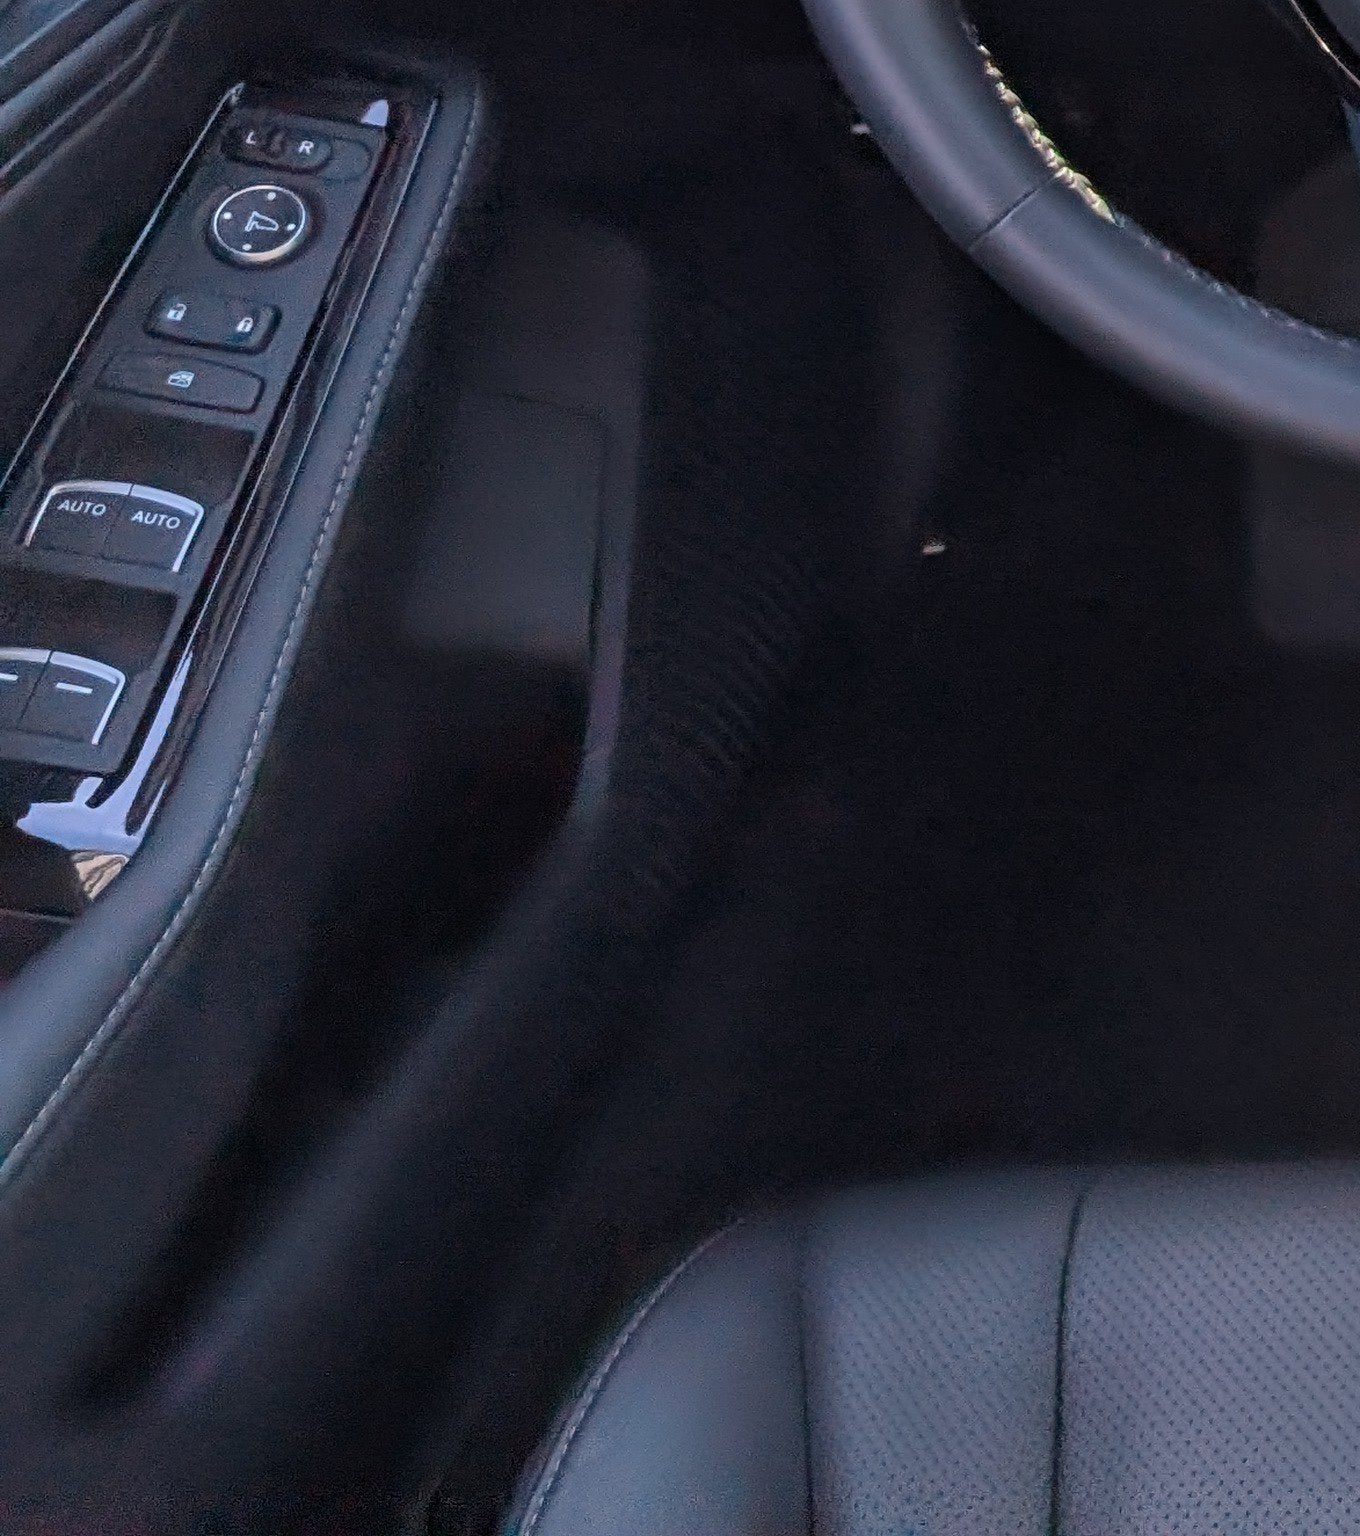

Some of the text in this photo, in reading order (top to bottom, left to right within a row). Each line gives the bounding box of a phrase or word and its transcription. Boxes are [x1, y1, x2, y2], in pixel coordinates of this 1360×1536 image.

[245, 129, 314, 156] L R
[56, 497, 182, 532] AUTO AUTO
